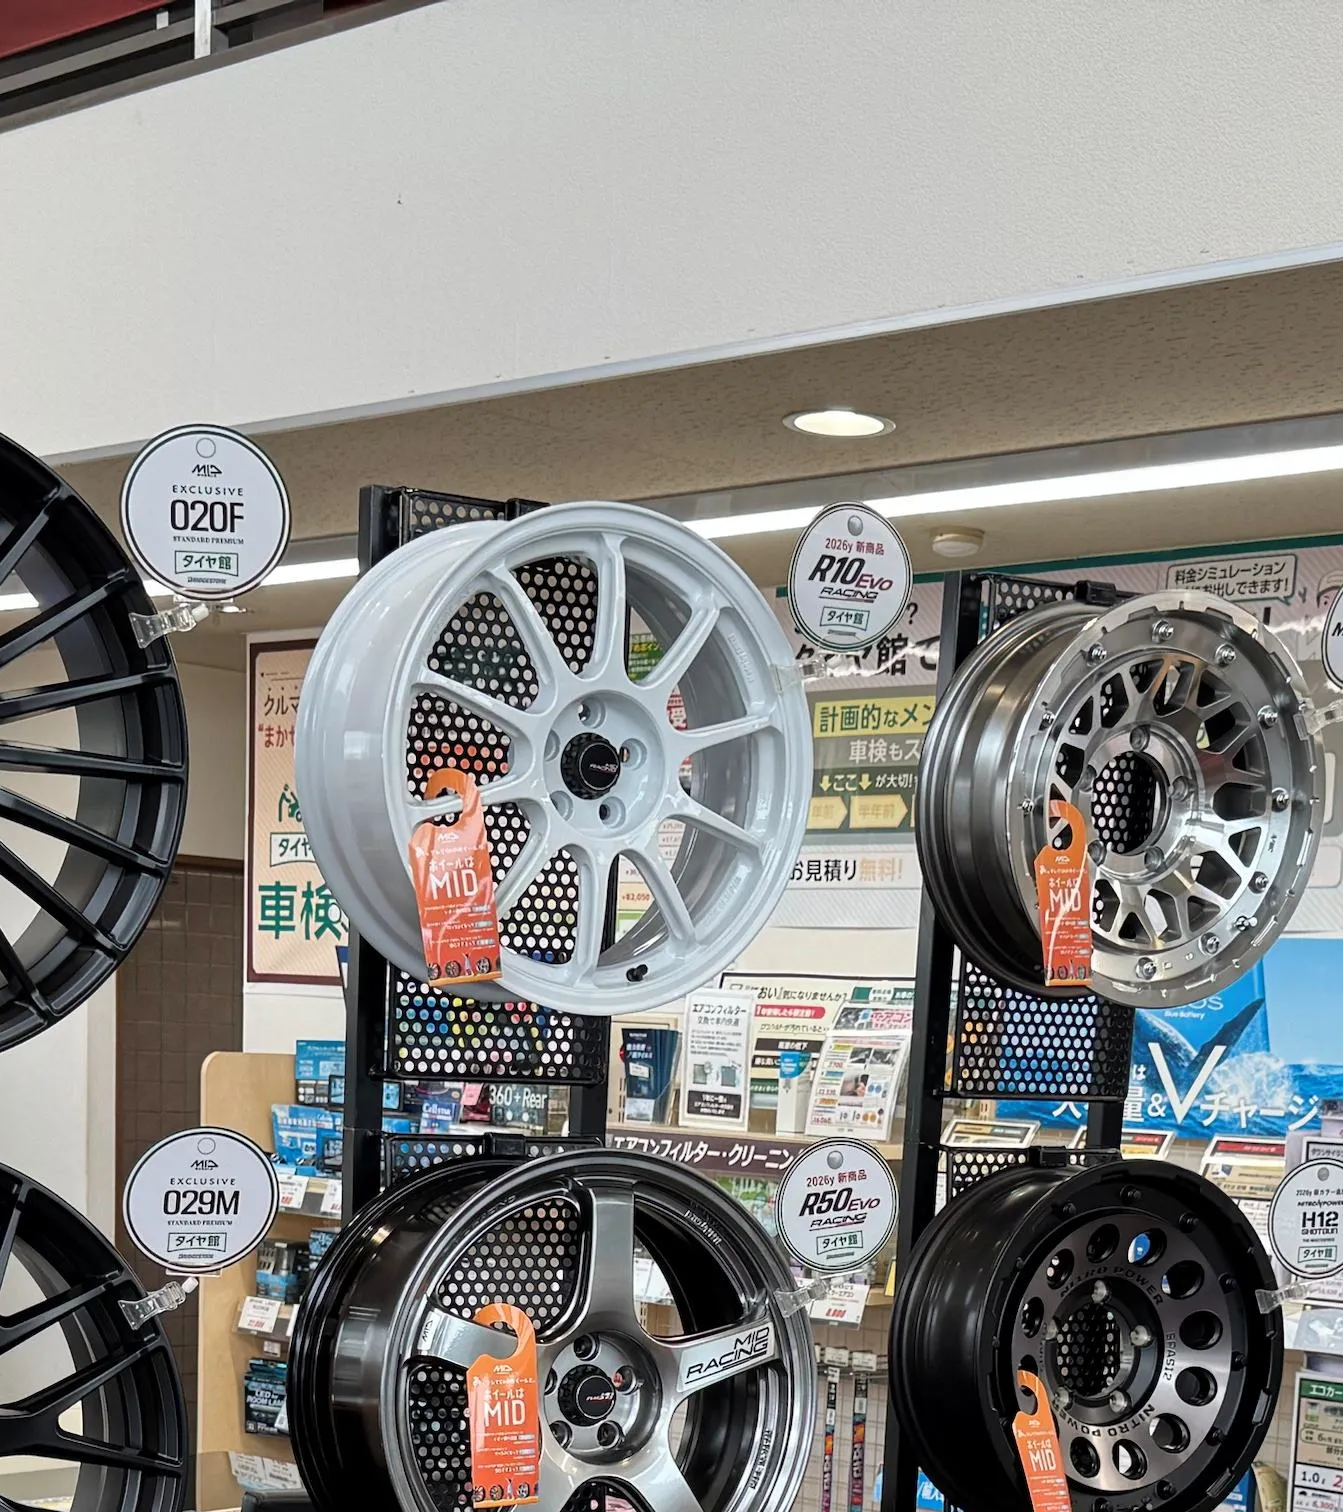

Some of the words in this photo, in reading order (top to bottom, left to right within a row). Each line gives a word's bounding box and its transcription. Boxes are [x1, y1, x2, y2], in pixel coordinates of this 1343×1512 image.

[172, 485, 243, 496] EXCLUSIVE
[171, 500, 244, 533] 020F
[211, 537, 244, 545] PREMIUM
[825, 538, 853, 553] 2026y
[856, 541, 885, 555] 新商品
[182, 555, 231, 570] タイヤ館
[808, 554, 865, 584] R10
[855, 574, 893, 591] EVO
[1174, 560, 1286, 584] 料金シミュレーション
[820, 587, 879, 599] RACING
[827, 612, 863, 625] タイヤ館
[429, 869, 479, 900] MID
[257, 880, 343, 941] 車検
[522, 1090, 548, 1109] Rear
[806, 1175, 834, 1187] 2026y
[838, 1170, 867, 1183] 新商品
[163, 1190, 240, 1215] 029M
[799, 1188, 853, 1217] R50
[848, 1199, 880, 1211] EVO
[810, 1213, 868, 1227] RACING
[1302, 1211, 1339, 1228] H12
[175, 1236, 220, 1247] タイヤ館
[822, 1235, 858, 1248] タイヤ館
[1303, 1248, 1332, 1258] タイヤ館
[733, 1326, 770, 1351] MID
[483, 1399, 526, 1428] MID
[1029, 1450, 1056, 1472] MID
